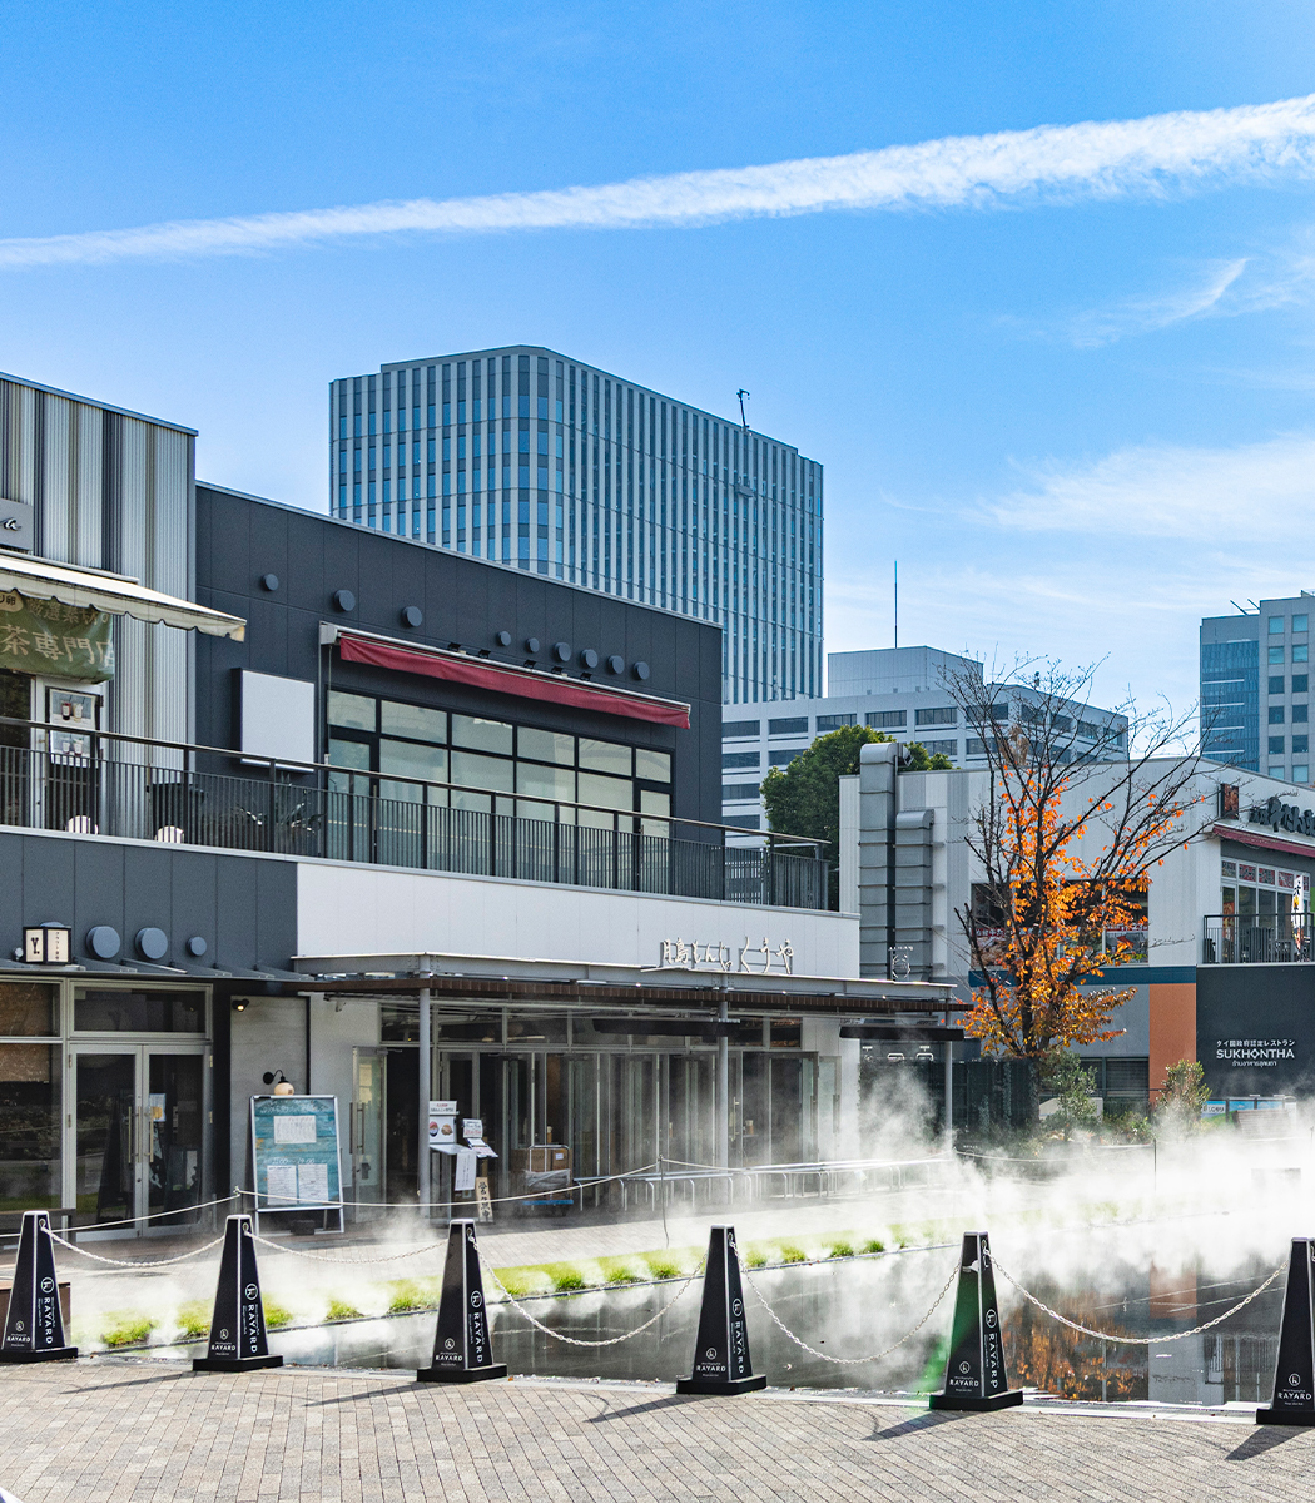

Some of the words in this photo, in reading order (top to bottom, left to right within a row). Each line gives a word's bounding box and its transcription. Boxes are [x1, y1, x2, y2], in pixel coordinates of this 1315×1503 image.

[740, 936, 794, 974] くうや
[1216, 1048, 1296, 1060] SUKHONTHA
[43, 1296, 54, 1345] RAYARD
[247, 1304, 258, 1354] RAYARD
[474, 1311, 483, 1364] RAYARD
[735, 1320, 745, 1374] RAYARD
[988, 1333, 998, 1389] RAYARD
